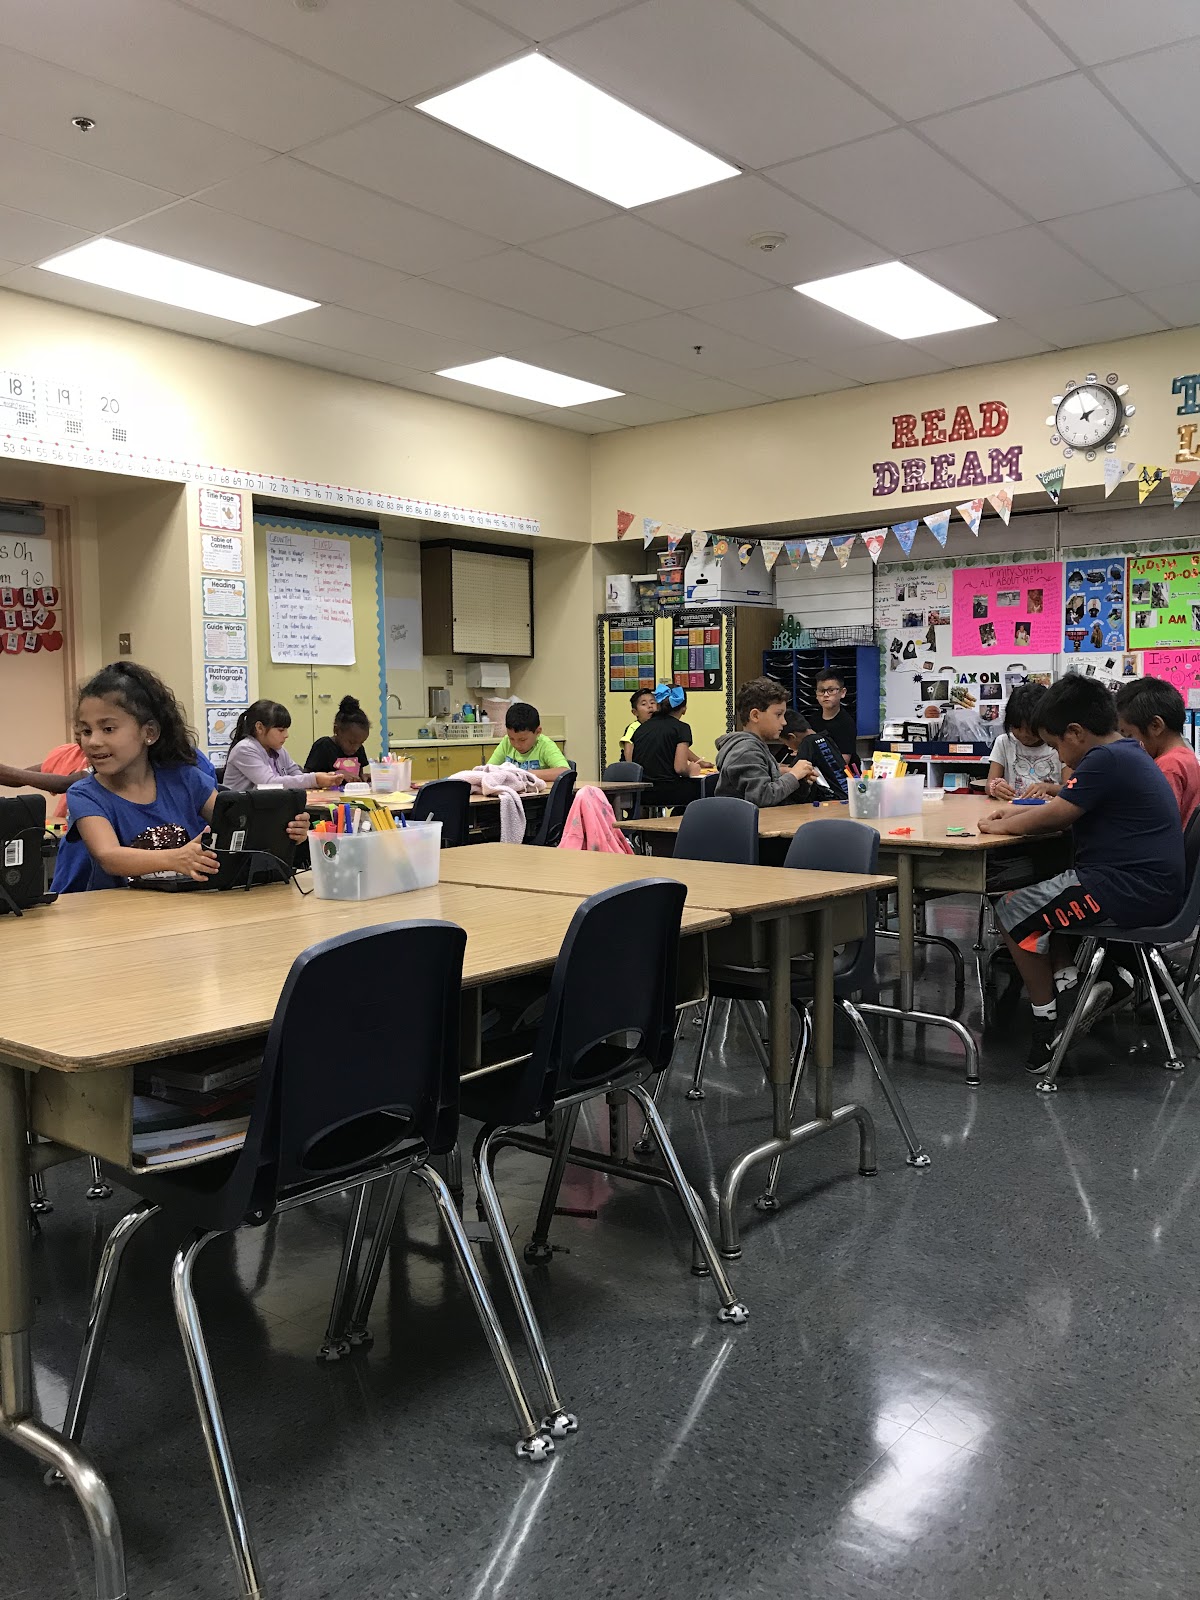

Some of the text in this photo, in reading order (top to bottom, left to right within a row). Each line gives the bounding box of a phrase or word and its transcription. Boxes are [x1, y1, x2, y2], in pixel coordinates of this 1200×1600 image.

[9, 378, 23, 396] 18
[57, 388, 70, 405] 19
[100, 396, 120, 414] 20
[892, 400, 1009, 449] READ
[872, 445, 1023, 496] DREAM
[1042, 469, 1064, 484] GORILLA
[4, 442, 15, 453] 53
[20, 445, 31, 455] 54
[36, 448, 48, 458] 55
[52, 450, 63, 460] 56
[68, 452, 78, 462] 57
[84, 454, 94, 464] 58
[208, 474, 217, 482] 67
[220, 475, 230, 484] 68
[232, 477, 242, 486] 69
[245, 479, 254, 488] 70
[258, 481, 264, 490] 71
[269, 483, 277, 492] 72
[281, 484, 288, 493] 73
[292, 486, 300, 495] 74
[303, 488, 310, 496] 75
[314, 490, 322, 498] 76
[325, 492, 332, 500] 77
[336, 493, 344, 502] 78
[346, 495, 354, 504] 79
[356, 496, 364, 505] 80
[367, 498, 373, 506] 81
[377, 500, 384, 508] 82
[387, 502, 394, 510] 83
[396, 504, 404, 512] 84
[415, 506, 422, 514] 86
[425, 508, 432, 516] 87
[443, 511, 450, 519] 89
[206, 491, 234, 503] Title Page
[210, 542, 233, 550] Contents
[211, 536, 225, 544] Table
[13, 541, 33, 562] Oh
[985, 565, 1043, 578] Trinity Smith
[1130, 558, 1177, 574] JUDITH
[211, 581, 236, 589] Heading
[980, 575, 1034, 588] ALL ABOUT ME
[1159, 614, 1187, 624] I AM
[206, 623, 223, 631] Guide
[1175, 652, 1188, 664] all
[208, 667, 238, 675] Illustration
[209, 674, 243, 682] Photograph
[954, 672, 1000, 684] JAXON
[818, 742, 837, 767] REAL
